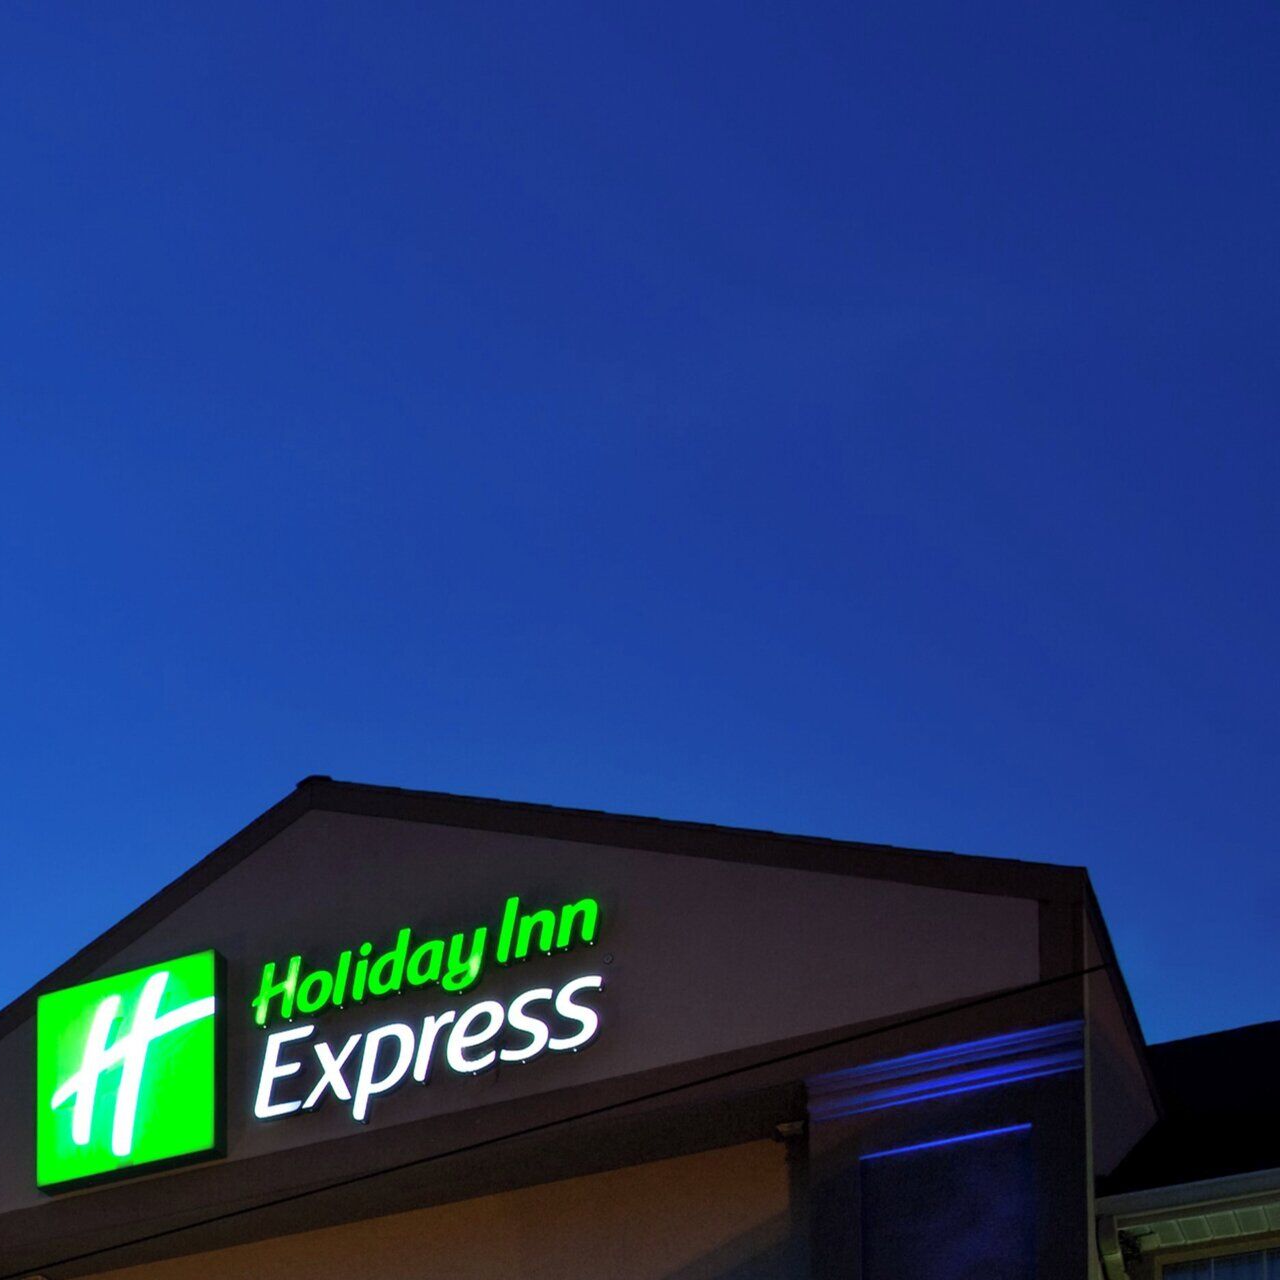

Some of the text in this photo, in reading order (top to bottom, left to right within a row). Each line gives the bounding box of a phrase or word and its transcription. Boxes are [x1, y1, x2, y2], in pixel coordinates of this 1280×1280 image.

[252, 897, 598, 1025] Holiday Inn
[253, 974, 602, 1121] Express
